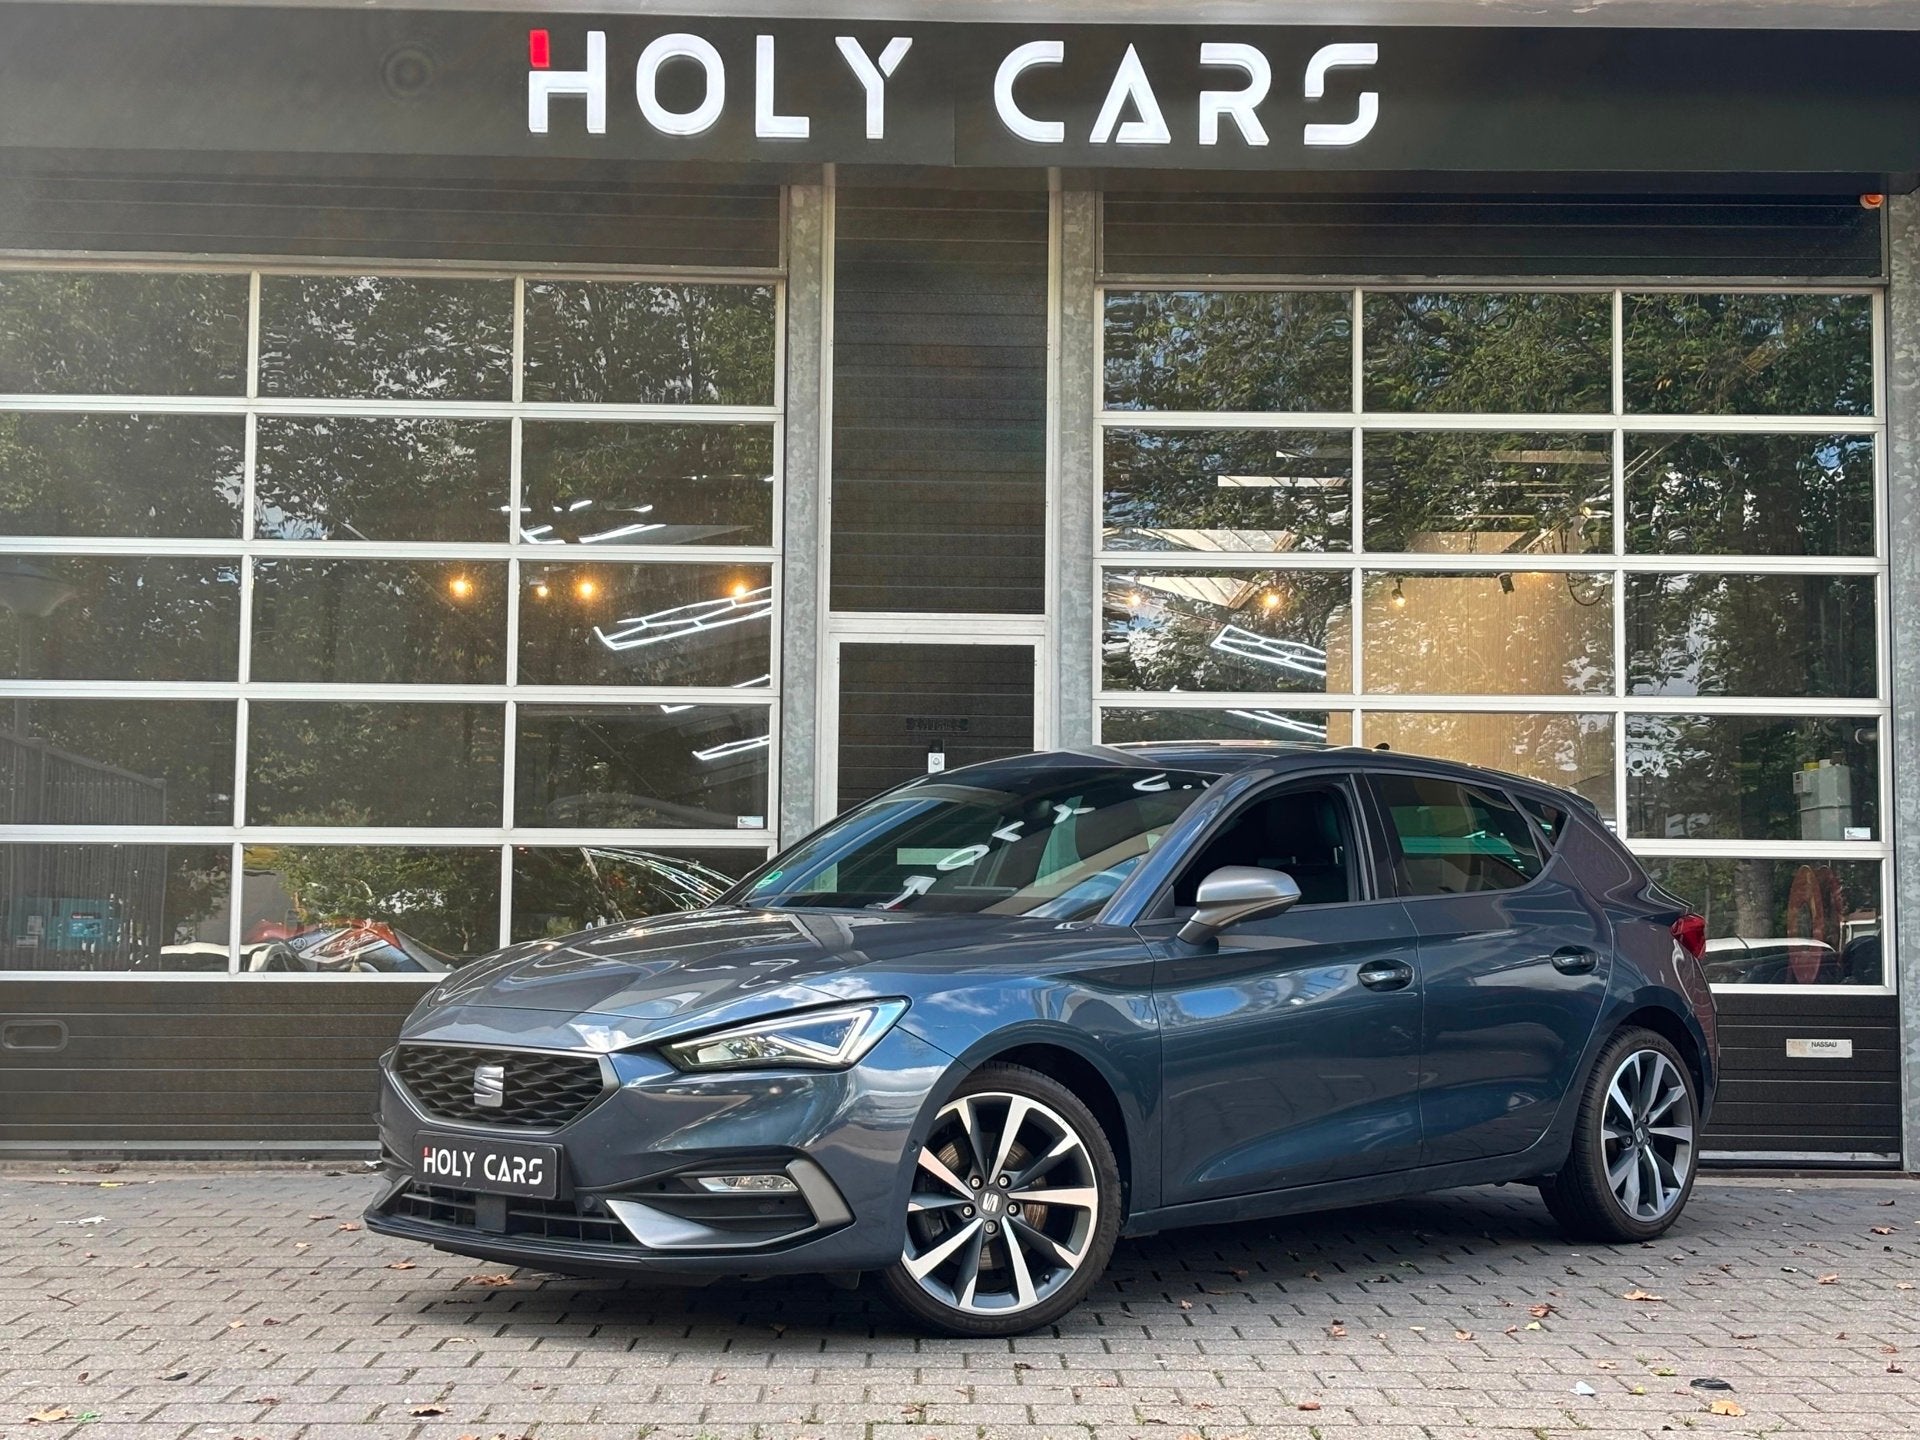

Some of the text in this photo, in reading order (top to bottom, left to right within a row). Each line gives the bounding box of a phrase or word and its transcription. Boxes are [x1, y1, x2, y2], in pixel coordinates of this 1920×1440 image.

[528, 29, 1379, 146] HOLY CARS
[422, 1146, 543, 1185] HOLY CARS
